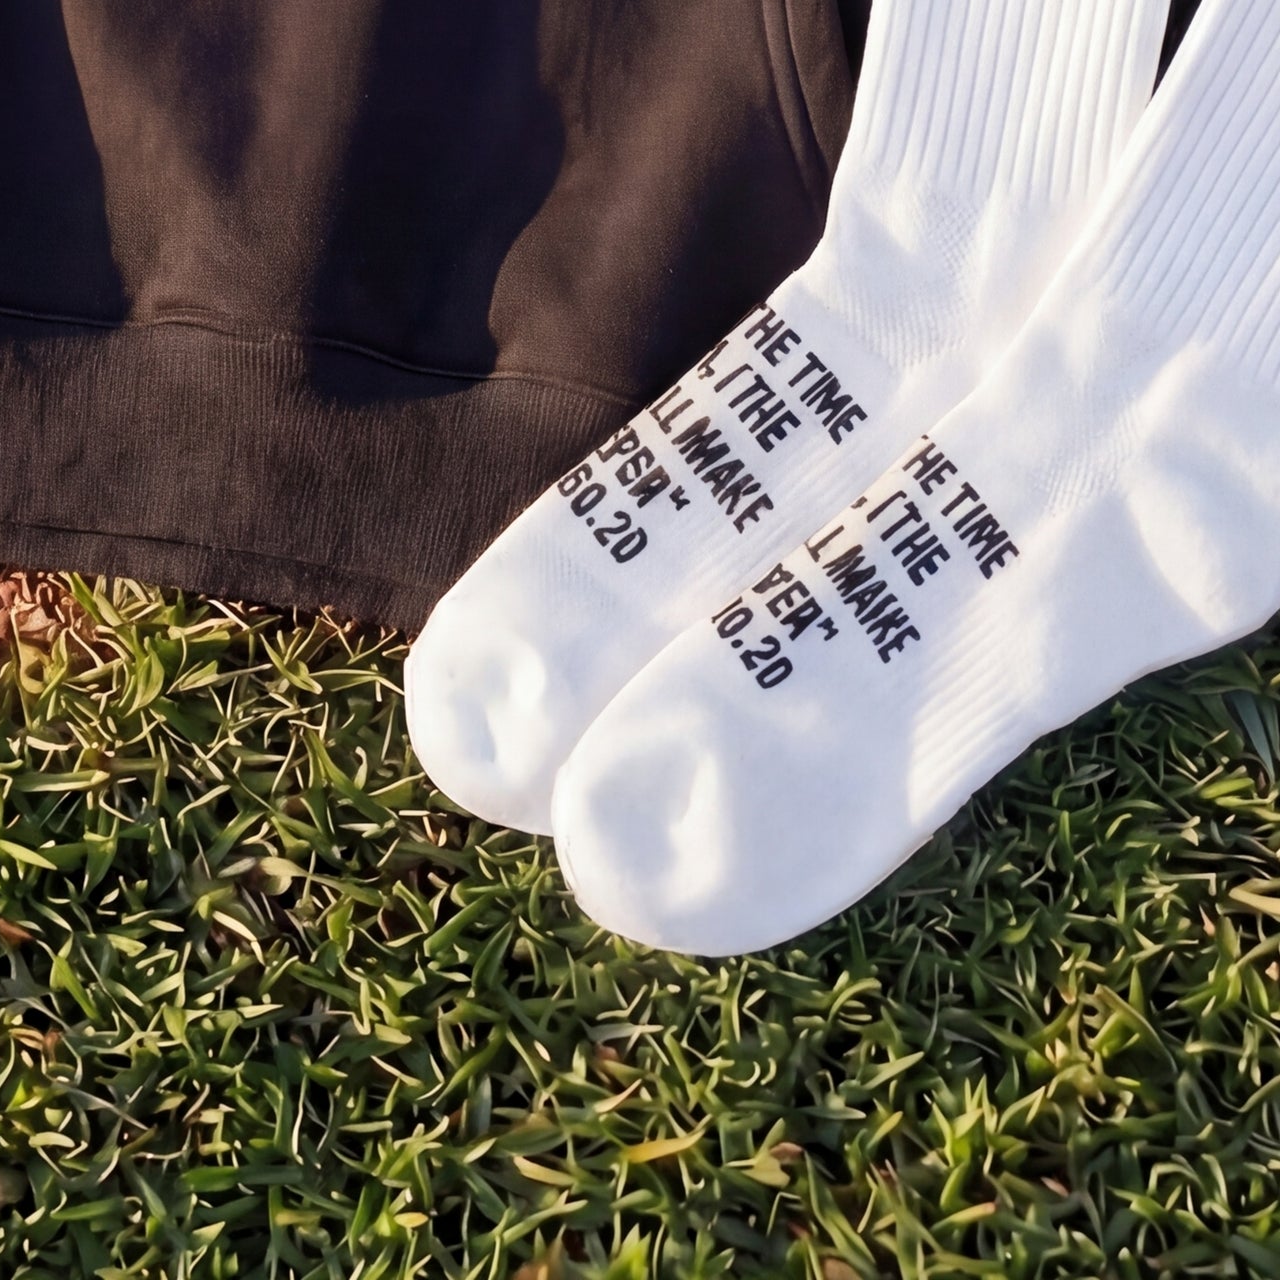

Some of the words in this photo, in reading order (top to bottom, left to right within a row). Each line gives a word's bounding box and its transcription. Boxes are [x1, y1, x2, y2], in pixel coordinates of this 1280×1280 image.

[729, 373, 802, 453] THE
[788, 352, 868, 446] TIME
[880, 501, 951, 587] THE
[940, 481, 1020, 580] TIME
